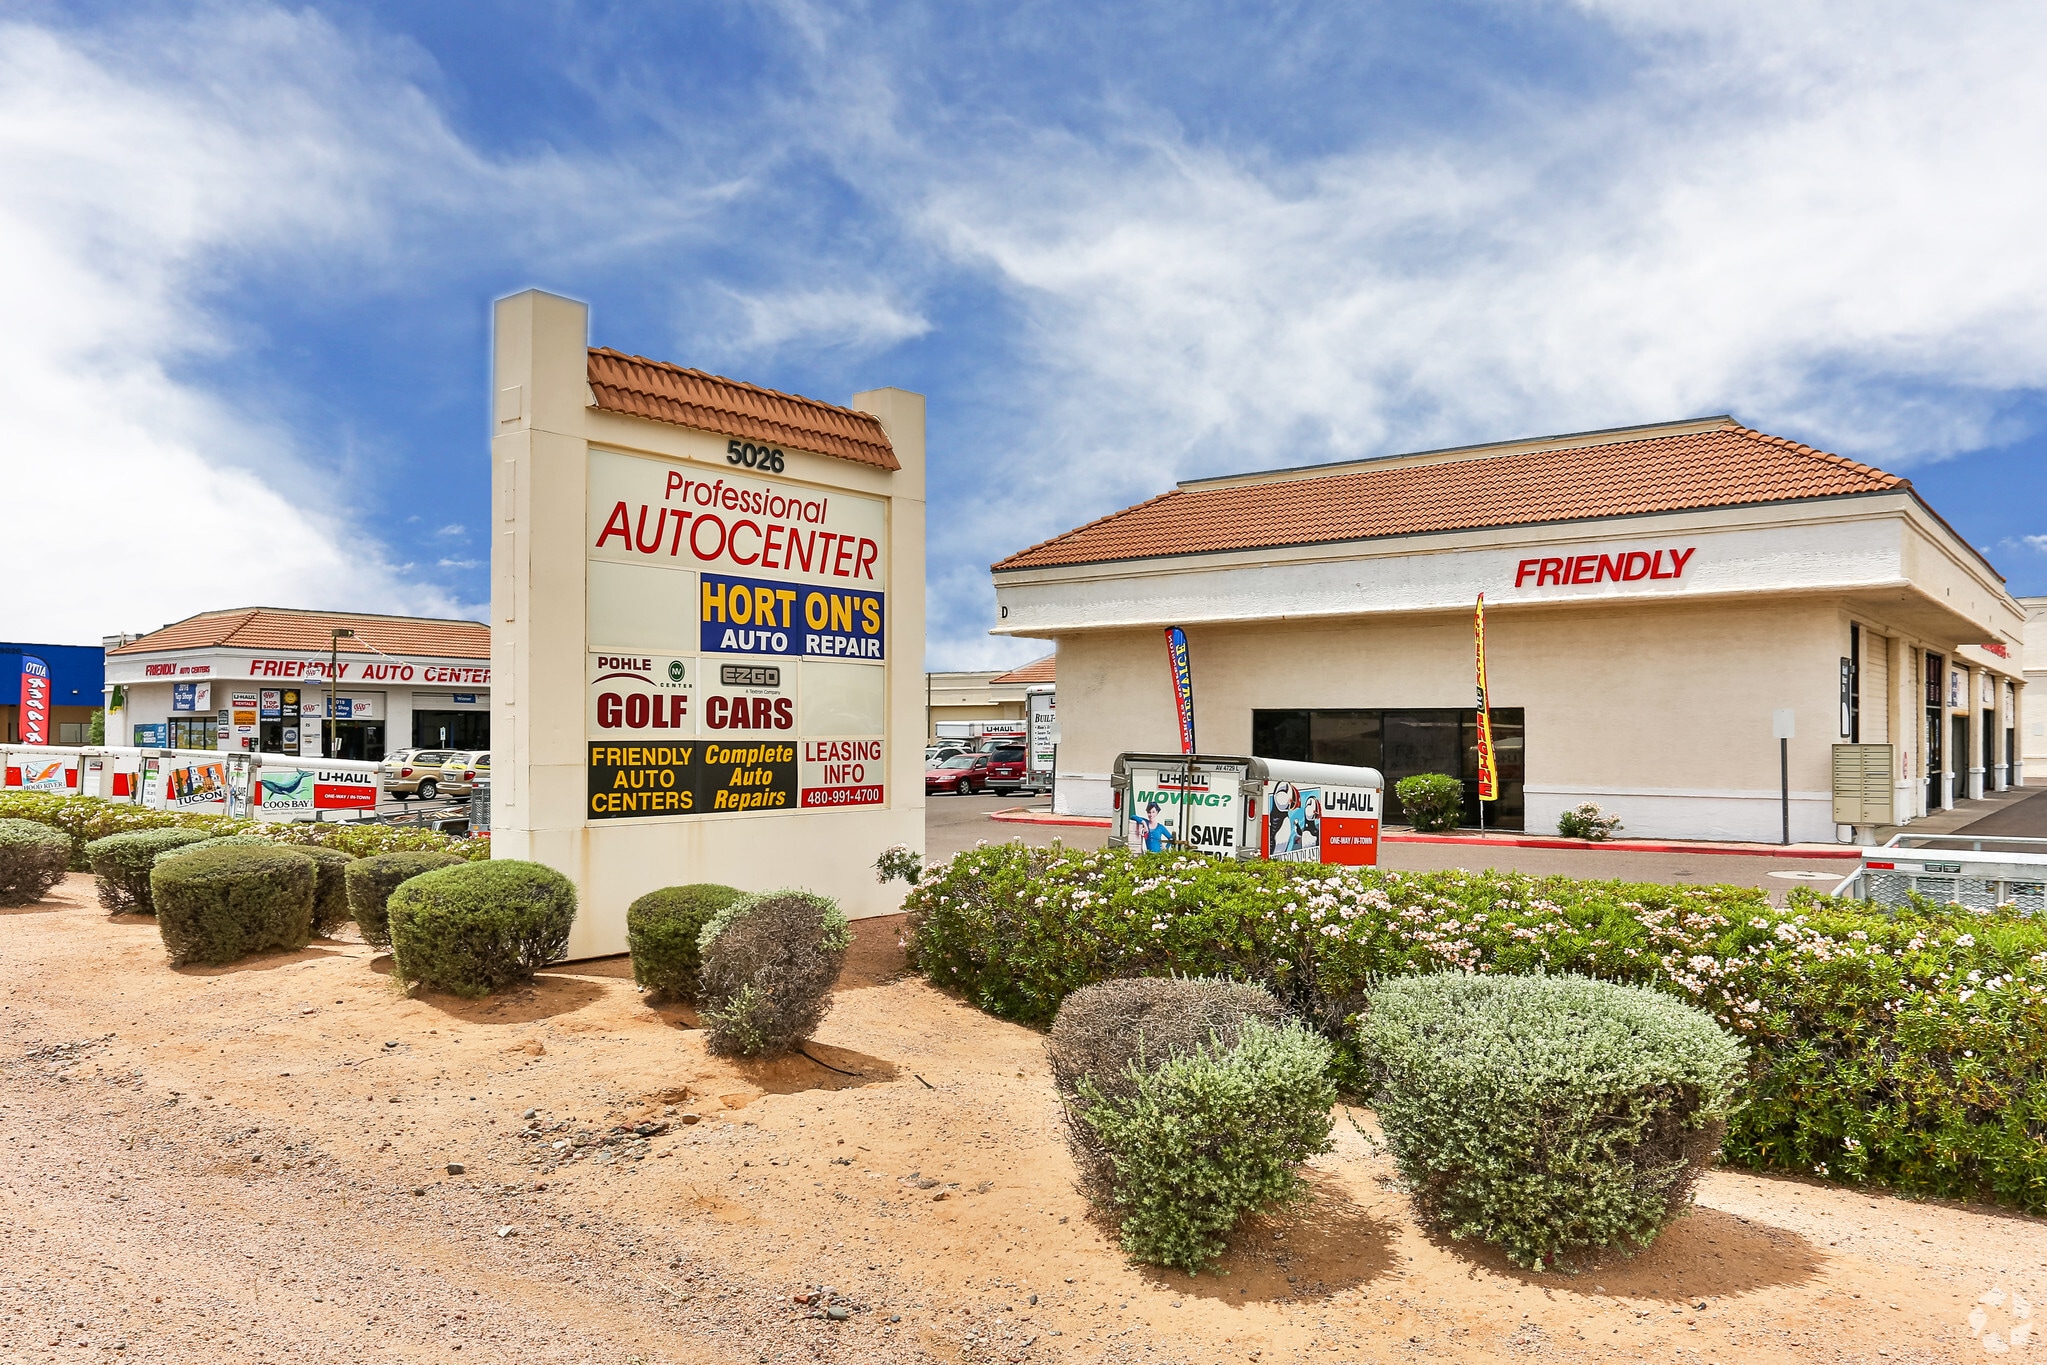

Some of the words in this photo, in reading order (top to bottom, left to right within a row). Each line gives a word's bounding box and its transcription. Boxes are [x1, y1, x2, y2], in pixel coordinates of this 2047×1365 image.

[726, 440, 785, 473] 5026
[665, 470, 827, 525] Professional
[595, 501, 878, 580] AUTOCENTER
[1515, 548, 1696, 587] FRIENDLY
[1001, 606, 1008, 618] D
[720, 629, 788, 652] AUTO
[805, 633, 881, 658] REPAIR
[145, 663, 177, 676] FRIENDLY
[191, 666, 210, 674] CENTERS
[362, 664, 414, 681] AUTO
[598, 656, 651, 671] POHLE
[722, 667, 779, 685] EZGO
[597, 692, 688, 729] GOLF
[706, 696, 793, 730] CARS
[592, 747, 693, 766] FRIENDLY
[705, 744, 793, 768] Complete
[806, 741, 881, 762] LEASING
[319, 772, 371, 783] U-HAUL
[613, 769, 675, 789] AUTO
[729, 767, 773, 787] Auto
[824, 763, 864, 784] INFO
[1160, 773, 1208, 785] U-HAUL
[23, 783, 43, 791] HOOD
[807, 788, 879, 804] 480-991-4700
[177, 790, 223, 805] TUCSON
[263, 800, 290, 809] COOS
[291, 800, 310, 808] BAY
[591, 791, 693, 813] CENTERS
[713, 788, 786, 811] Repairs
[1137, 791, 1232, 807] MOVING?
[1324, 791, 1373, 812] U-HAUL
[1191, 825, 1233, 847] SAVE
[1330, 836, 1350, 845] ONE-WAY
[1354, 837, 1373, 845] IN-TOWN
